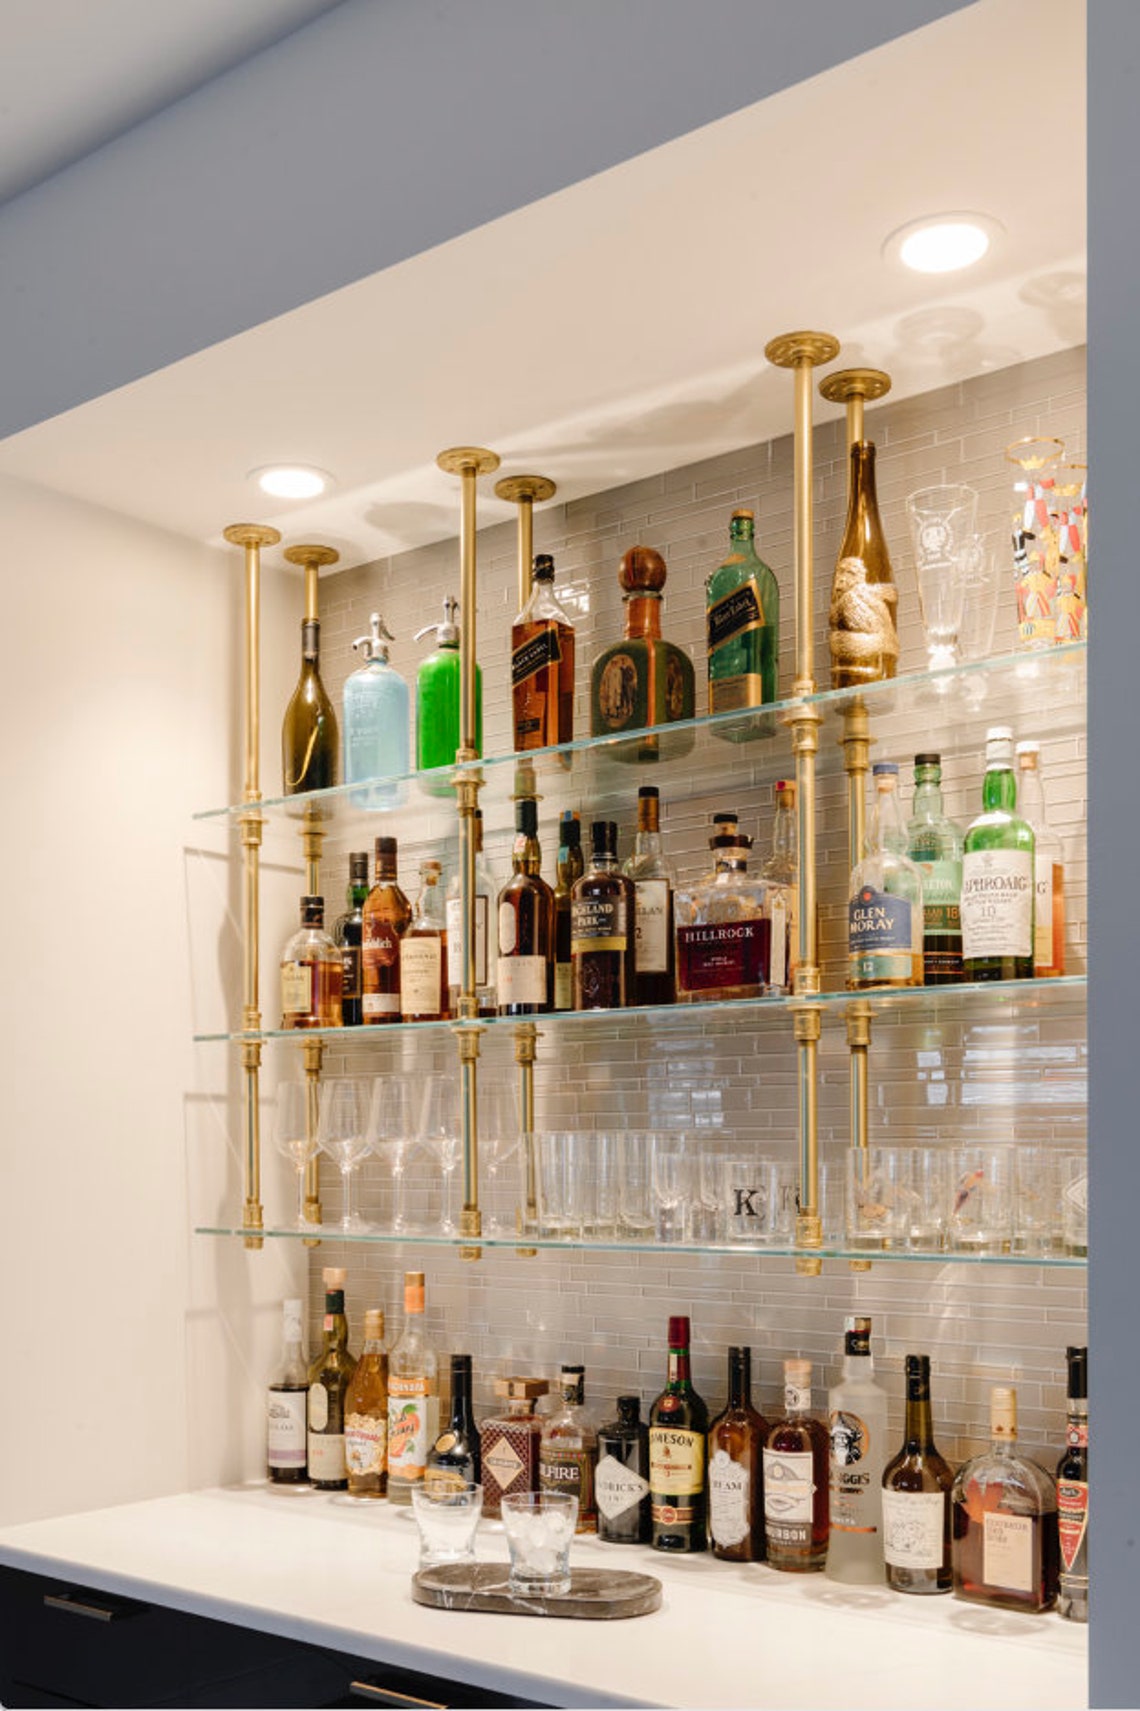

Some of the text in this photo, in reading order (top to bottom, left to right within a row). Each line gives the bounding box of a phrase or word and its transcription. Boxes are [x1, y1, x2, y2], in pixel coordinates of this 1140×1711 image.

[854, 907, 886, 921] GLEN
[851, 918, 894, 934] MORAY
[685, 927, 754, 943] HILLROCK
[734, 1189, 758, 1216] K
